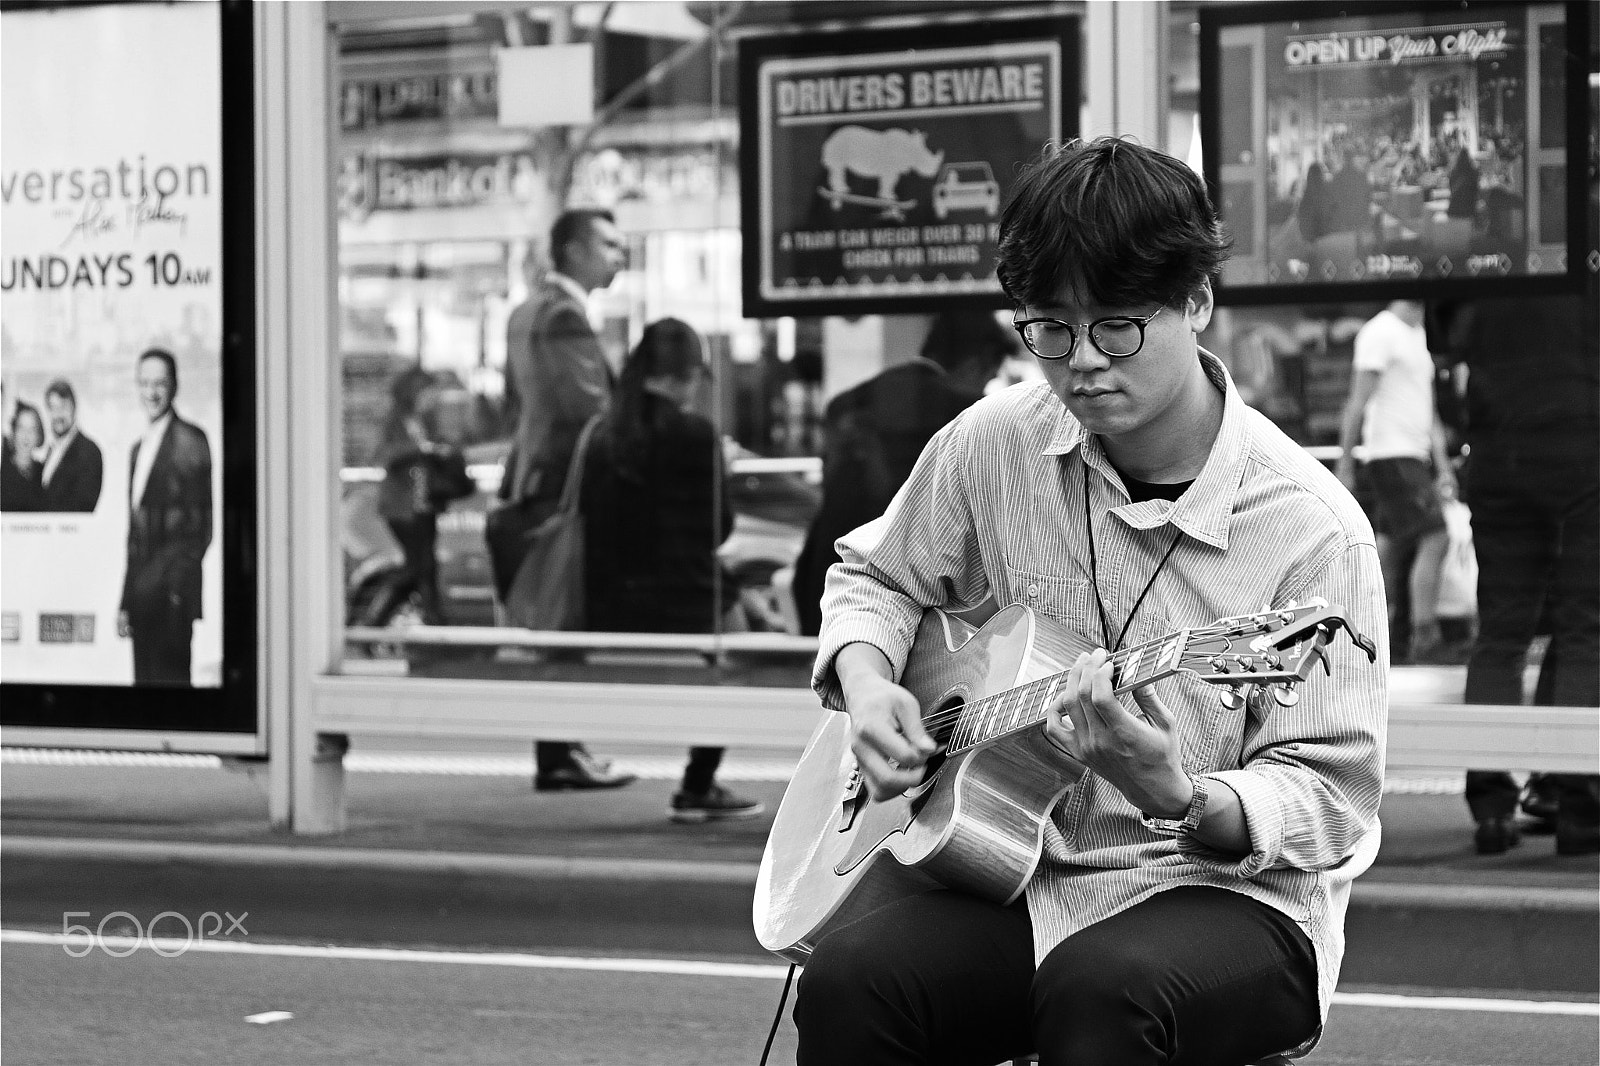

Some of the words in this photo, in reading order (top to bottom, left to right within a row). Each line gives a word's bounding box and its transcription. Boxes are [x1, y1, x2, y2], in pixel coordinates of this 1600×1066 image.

[1285, 37, 1350, 66] OPEN
[1354, 35, 1387, 60] UP
[777, 73, 905, 117] DRIVERS
[910, 63, 1044, 106] BEWARE
[922, 224, 961, 244] OVER
[1, 254, 133, 290] UNDAYS
